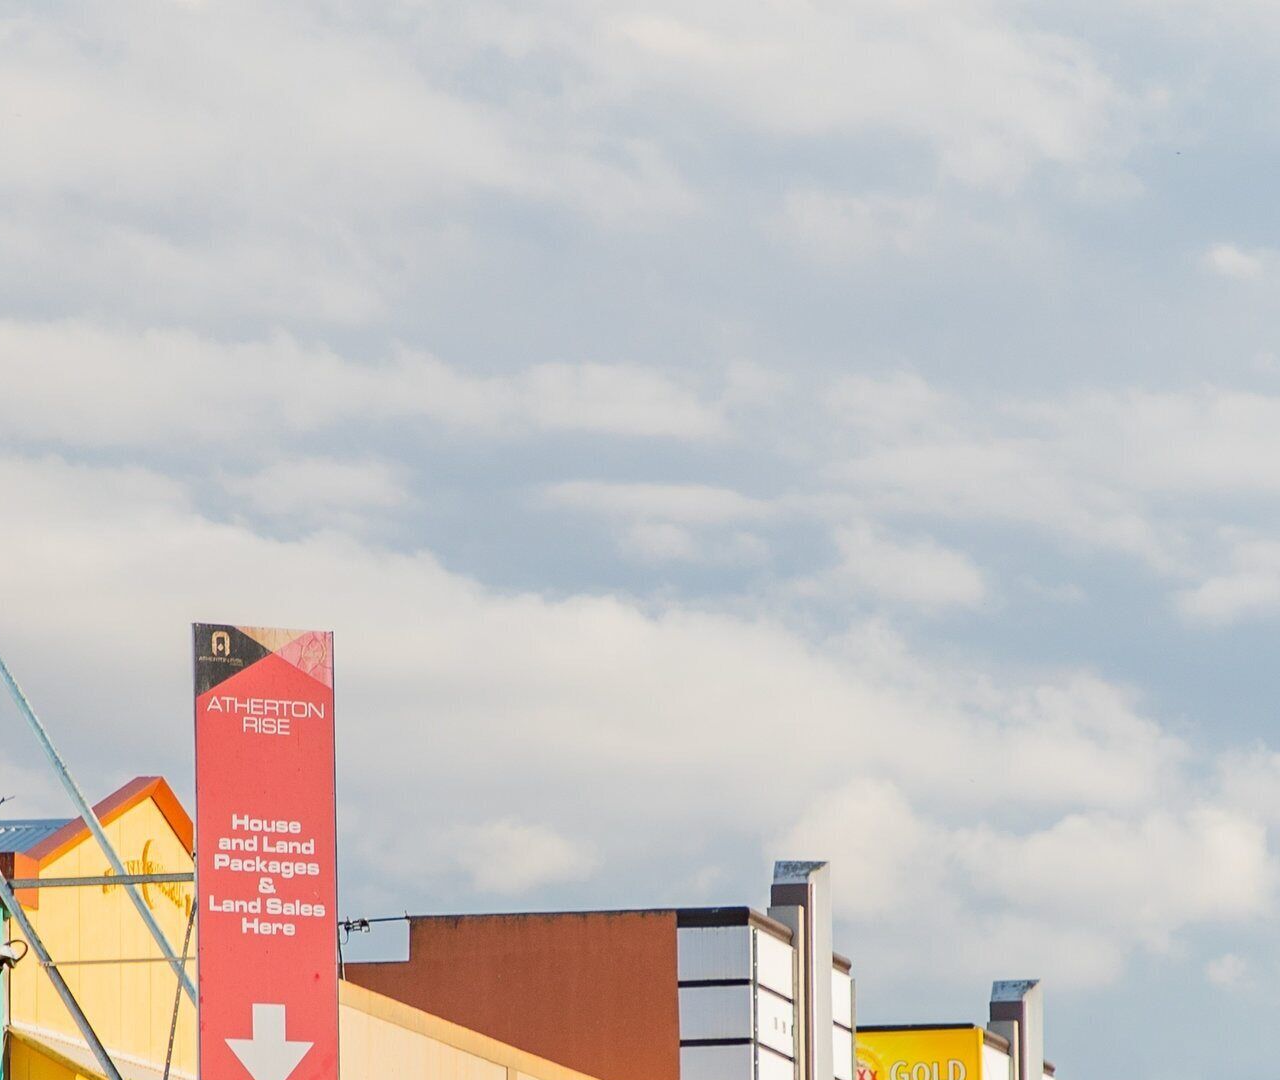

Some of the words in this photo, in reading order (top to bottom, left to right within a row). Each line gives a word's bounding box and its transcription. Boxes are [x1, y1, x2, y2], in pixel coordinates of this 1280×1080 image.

[206, 695, 325, 719] ATHERTON
[243, 716, 290, 735] RISE
[231, 813, 302, 834] House
[218, 835, 258, 852] and
[262, 836, 315, 855] Land
[214, 853, 320, 879] Packages
[258, 877, 276, 894] &
[209, 895, 261, 914] Land
[266, 897, 326, 918] Sales
[241, 917, 296, 937] Here
